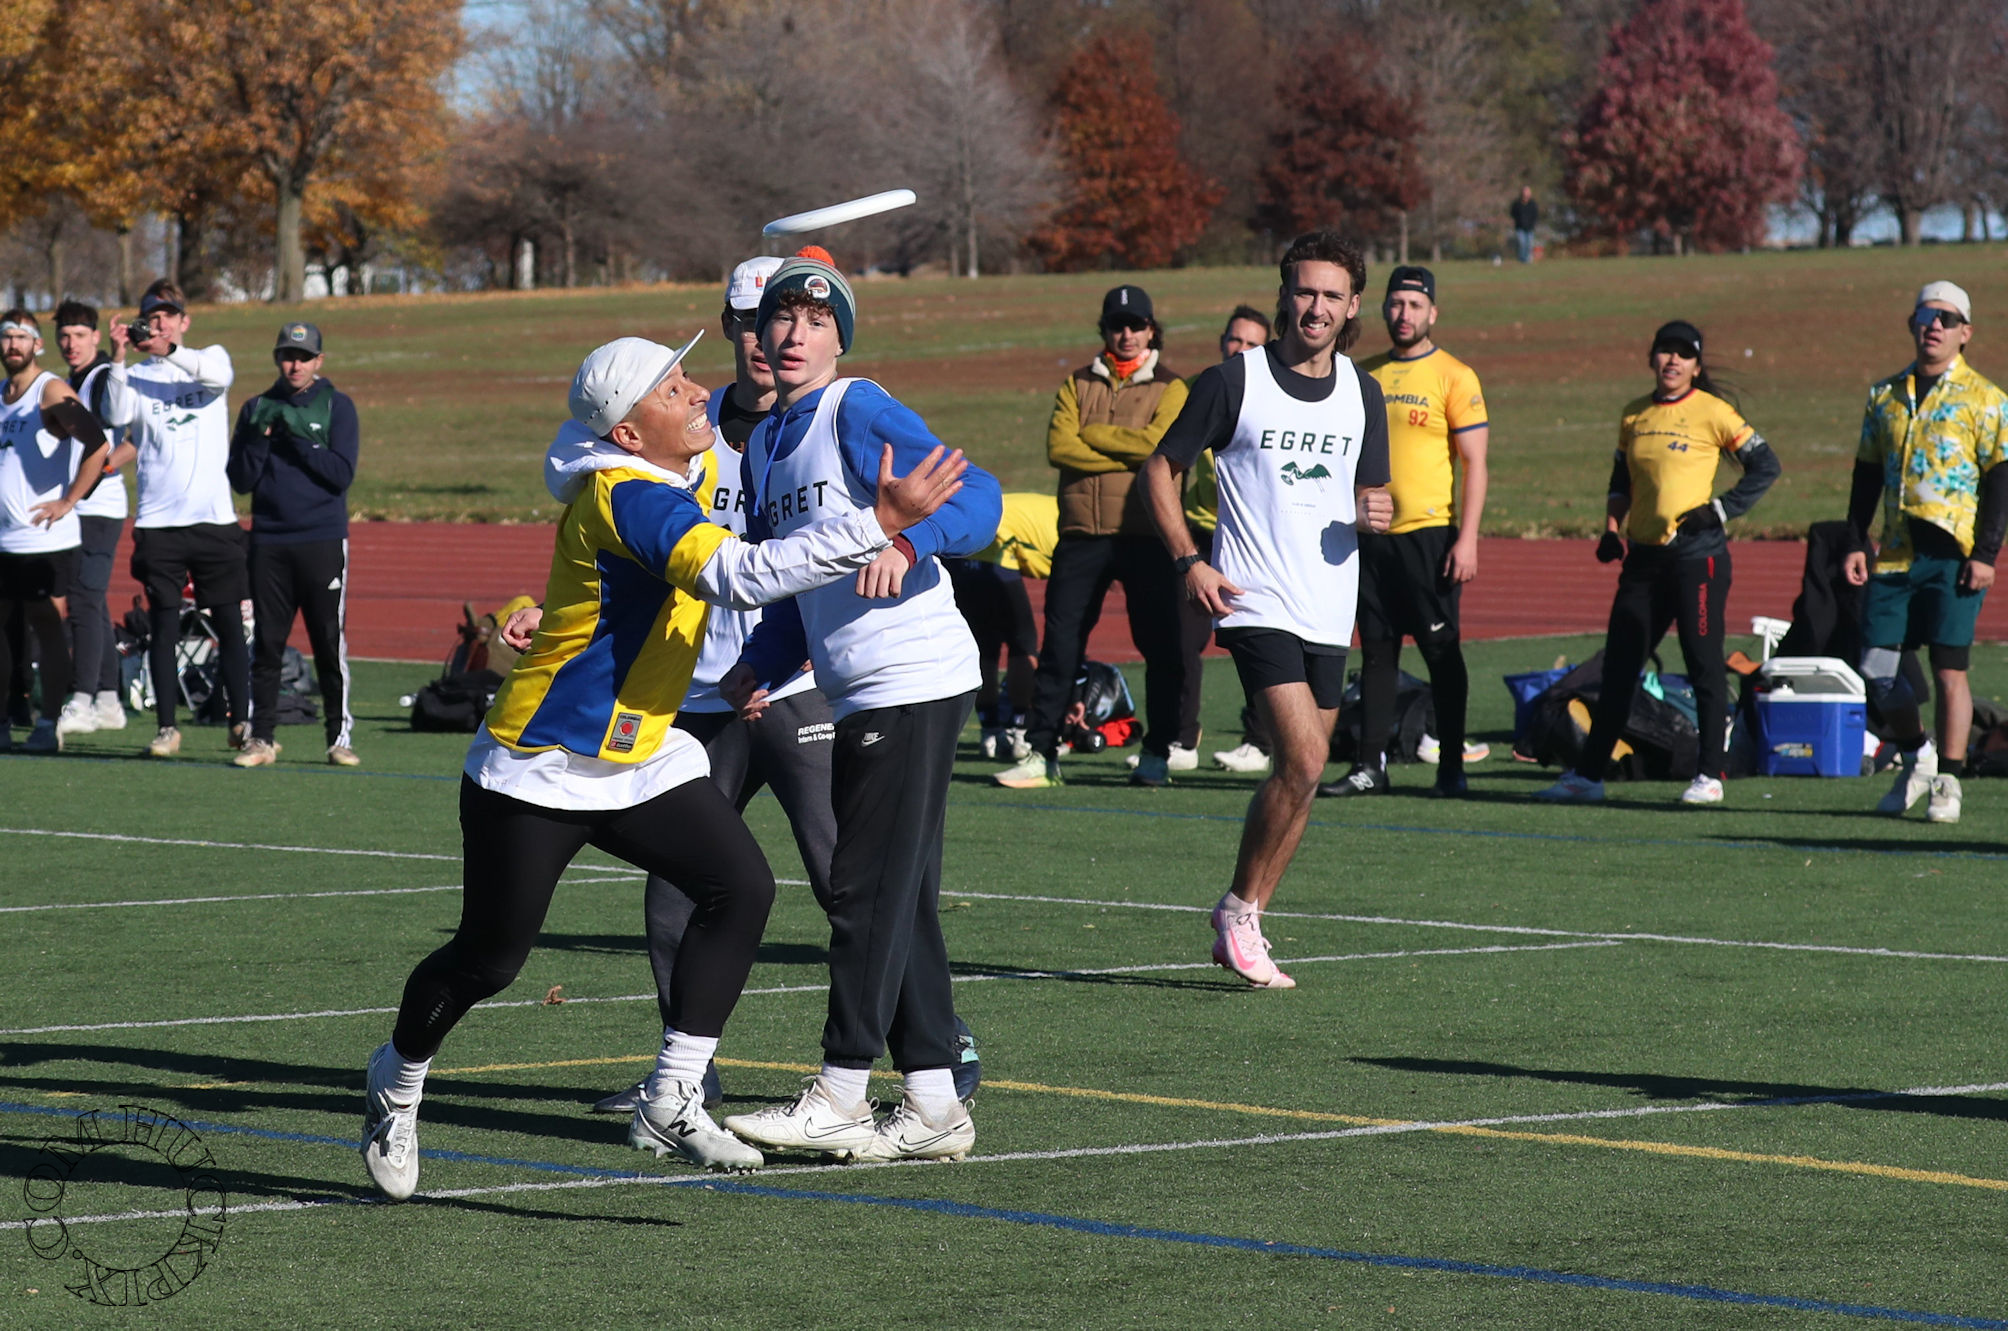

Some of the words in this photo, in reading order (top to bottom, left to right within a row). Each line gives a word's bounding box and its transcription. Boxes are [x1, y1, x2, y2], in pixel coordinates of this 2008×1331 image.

[152, 390, 204, 415] EGRET
[1385, 394, 1429, 408] OMBIA
[2, 419, 27, 432] RET
[1409, 409, 1429, 427] 92
[1260, 430, 1352, 456] EGRET
[1668, 441, 1688, 452] 44
[713, 487, 746, 513] GR
[769, 480, 828, 527] GRET
[798, 722, 834, 736] REGENE
